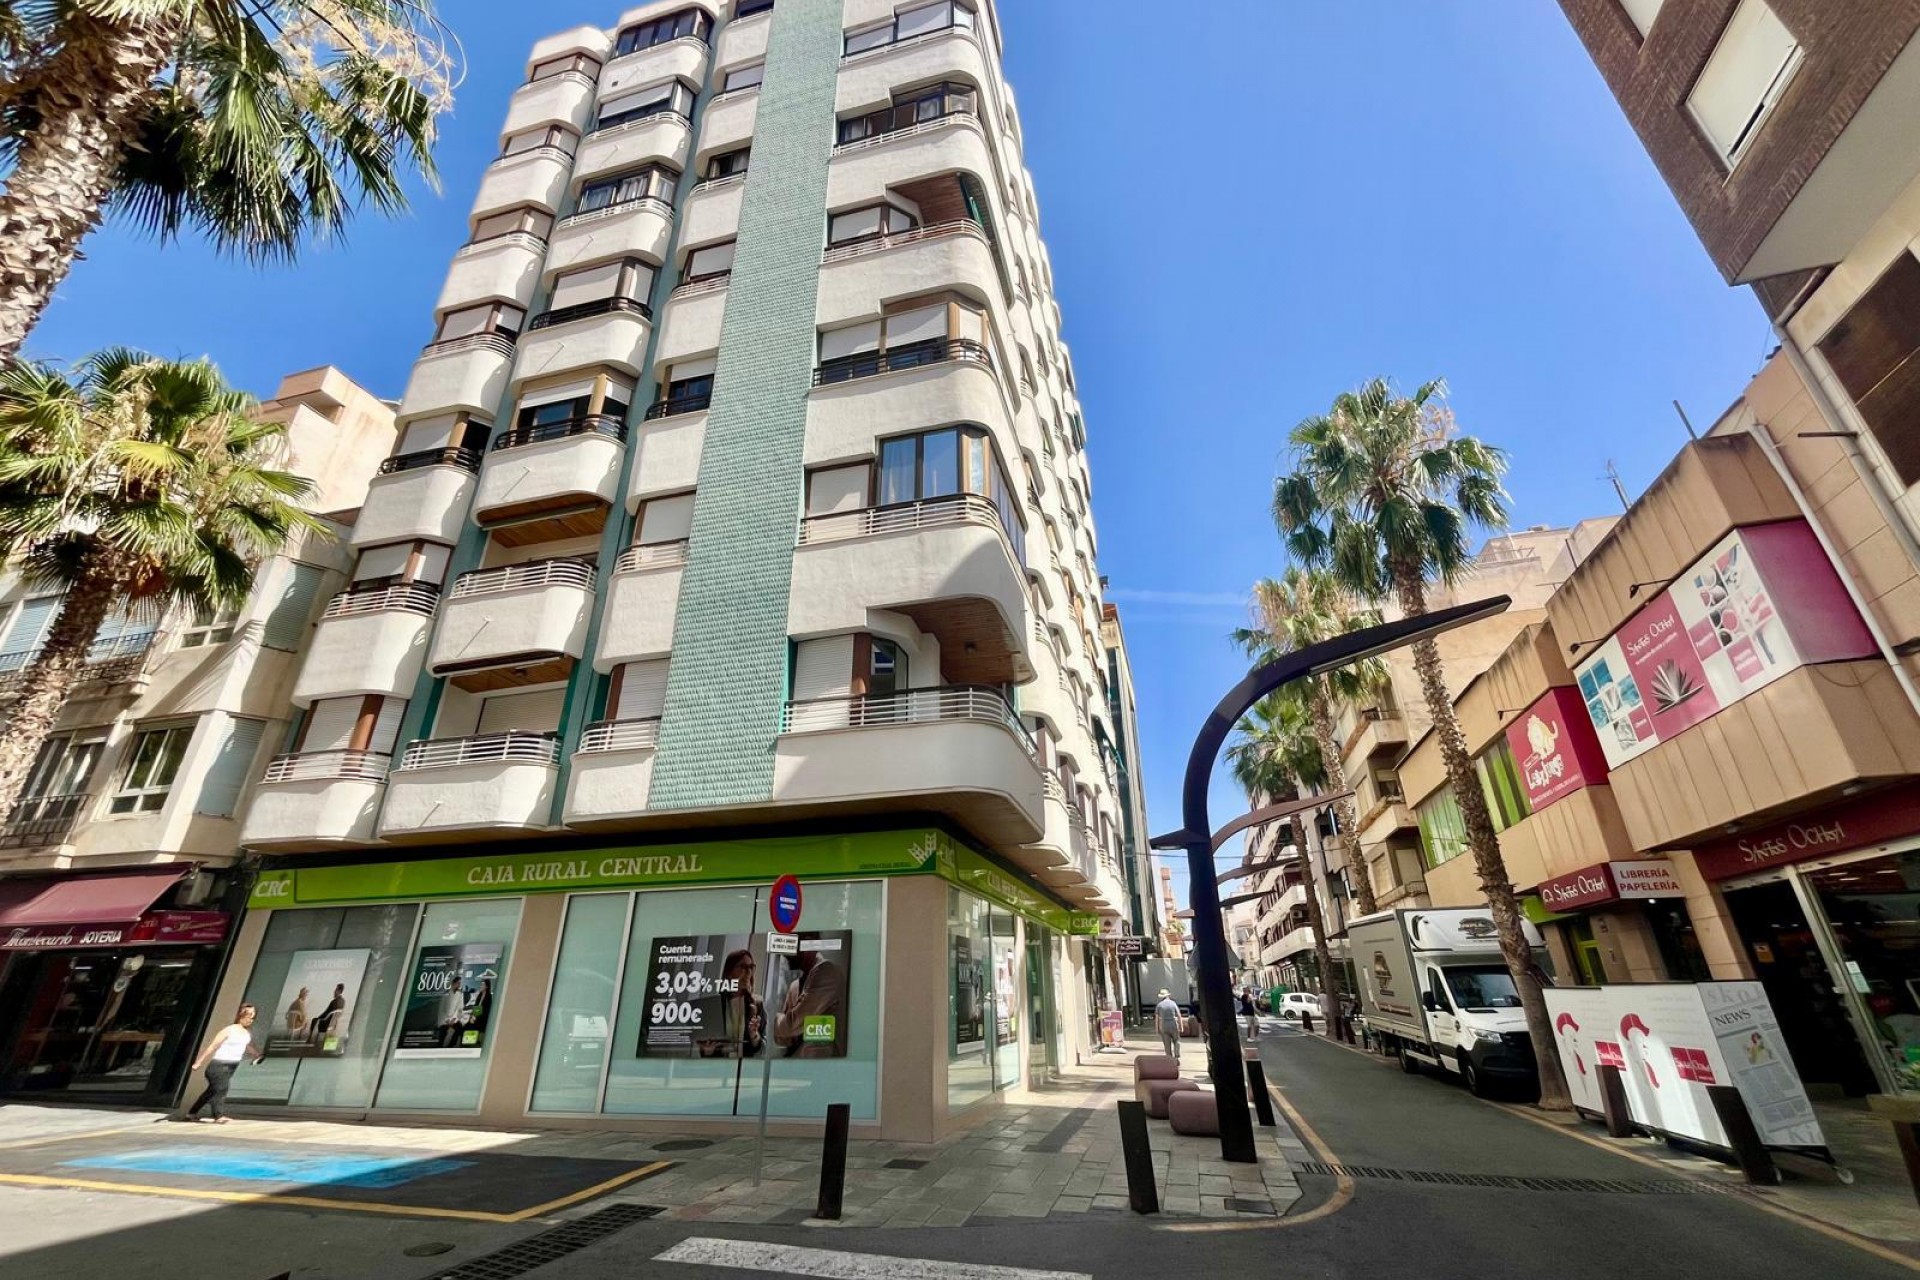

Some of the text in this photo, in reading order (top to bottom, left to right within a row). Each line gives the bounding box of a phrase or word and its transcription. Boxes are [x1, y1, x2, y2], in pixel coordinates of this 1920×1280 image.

[467, 854, 703, 884] CAJA RURAL CENTRAL
[1619, 868, 1670, 879] LIBRERÍA
[254, 879, 291, 897] CRC
[1619, 881, 1680, 892] PAPELERÍA
[1072, 917, 1098, 928] CRC
[660, 945, 692, 954] Cuenta
[658, 952, 714, 963] remunerada
[654, 971, 739, 997] 3,03% TAE
[1713, 1008, 1752, 1025] NEWS
[805, 1024, 832, 1036] CRC
